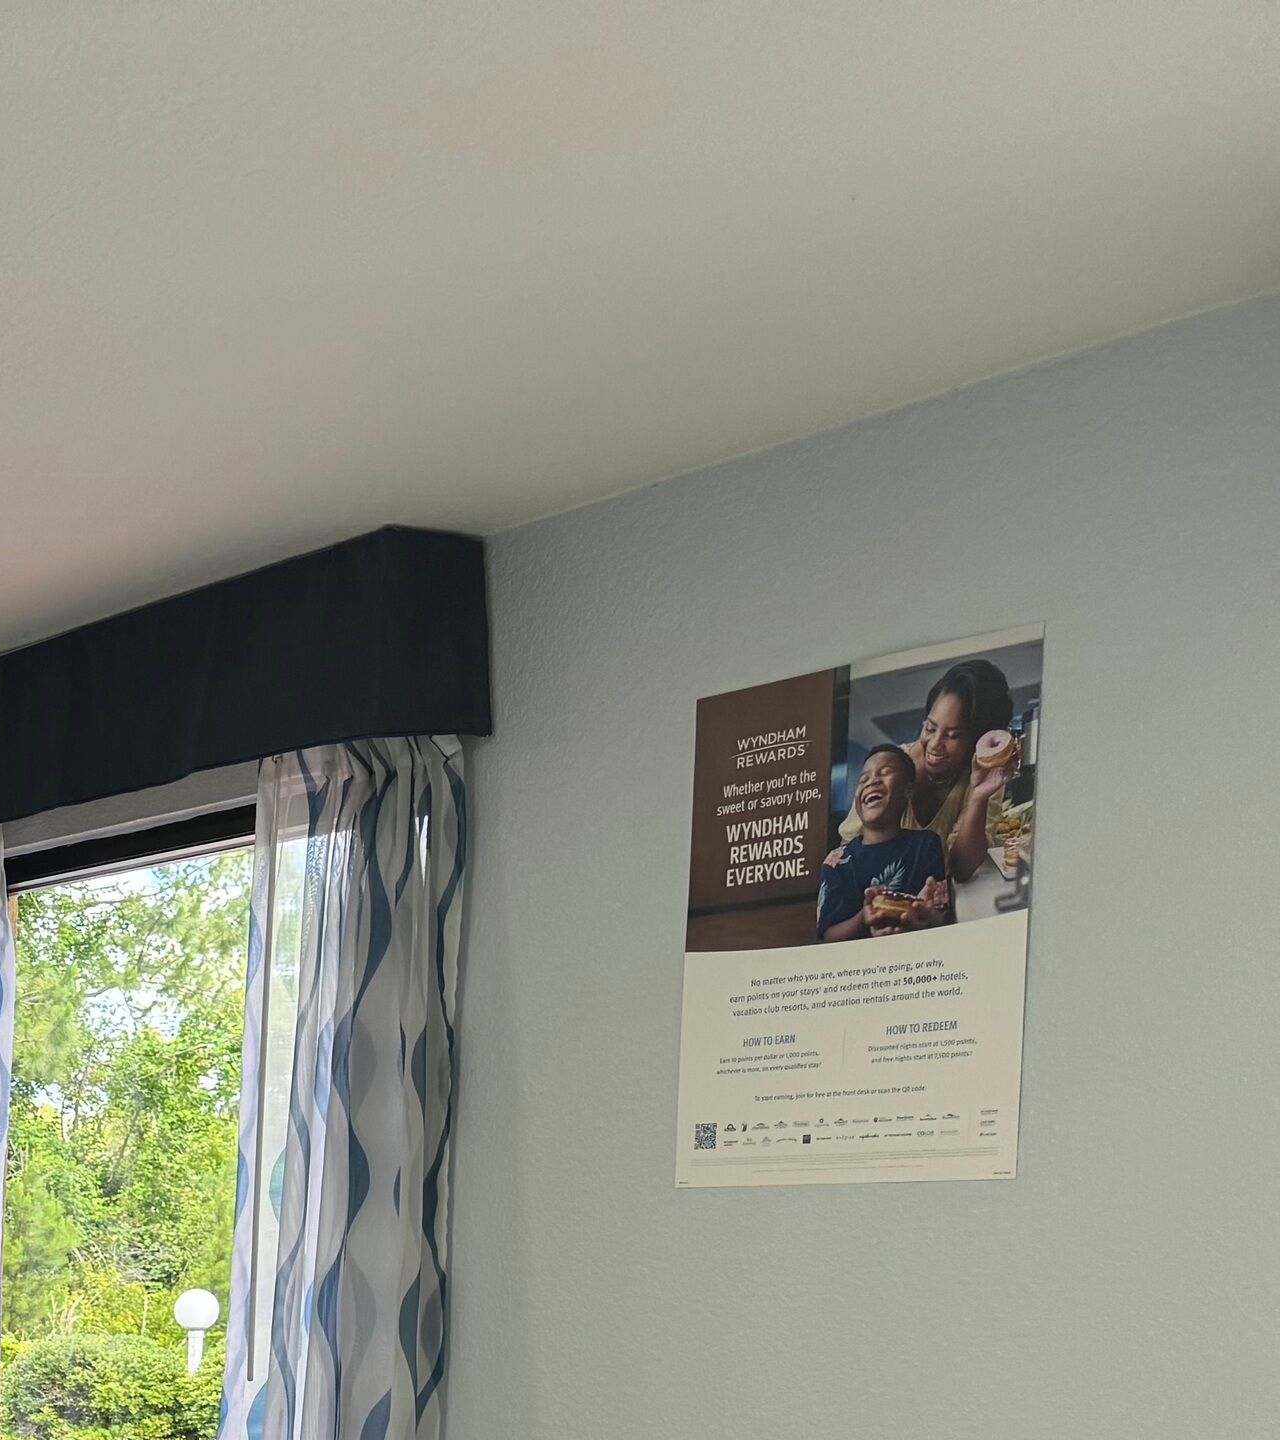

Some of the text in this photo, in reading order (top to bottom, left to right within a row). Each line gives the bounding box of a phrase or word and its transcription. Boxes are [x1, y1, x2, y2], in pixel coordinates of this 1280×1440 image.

[737, 725, 807, 751] WYNDHAM
[736, 744, 805, 769] REWARDS
[723, 769, 817, 798] Whether you're the
[716, 787, 822, 817] sweet or savory type,
[726, 811, 809, 843] WYNDHAM
[730, 835, 804, 865] REWARDS
[726, 857, 810, 888] EVERYONE.
[747, 992, 769, 1003] points
[781, 990, 798, 999] your
[823, 985, 838, 994] and
[840, 982, 869, 992] redeem
[871, 980, 891, 989] them
[893, 979, 901, 987] at
[903, 974, 937, 986] 50,000+
[940, 971, 968, 981] hotels,
[751, 959, 944, 987] No matter who you are, where you're going, or why,
[732, 1008, 762, 1017] vacation
[764, 1005, 779, 1014] club
[827, 998, 860, 1007] vacation
[862, 994, 889, 1004] rentals
[891, 991, 920, 1001] around
[922, 989, 935, 998] the
[937, 987, 963, 996] world.
[742, 1034, 796, 1048] HOW TO EARN
[886, 1020, 958, 1035] HOW TO REDEEM
